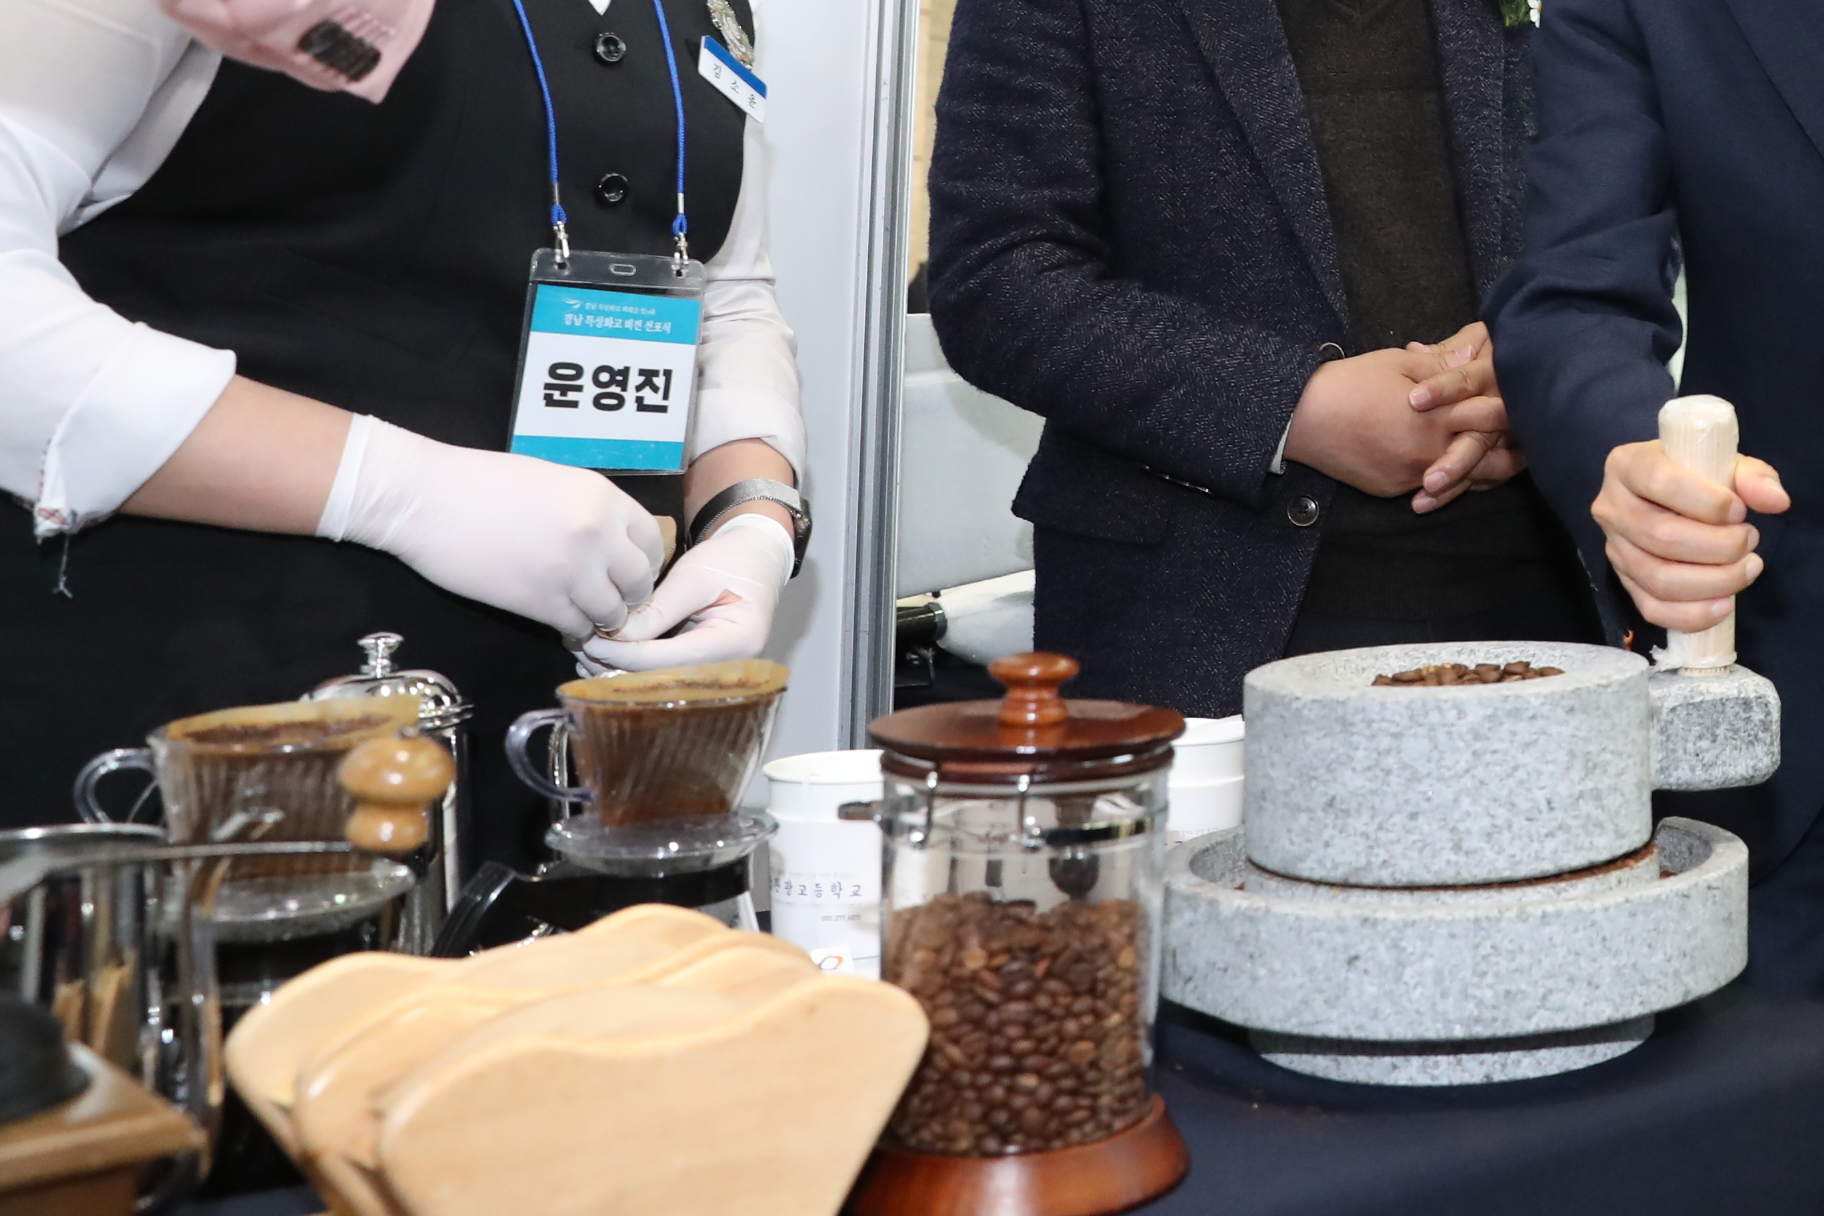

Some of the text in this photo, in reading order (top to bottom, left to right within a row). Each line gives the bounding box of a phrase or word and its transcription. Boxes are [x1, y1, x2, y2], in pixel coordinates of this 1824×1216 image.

[563, 313, 584, 326] 경남
[585, 314, 623, 329] 특성화고
[645, 320, 672, 334] 선포식
[542, 361, 673, 414] 운영진
